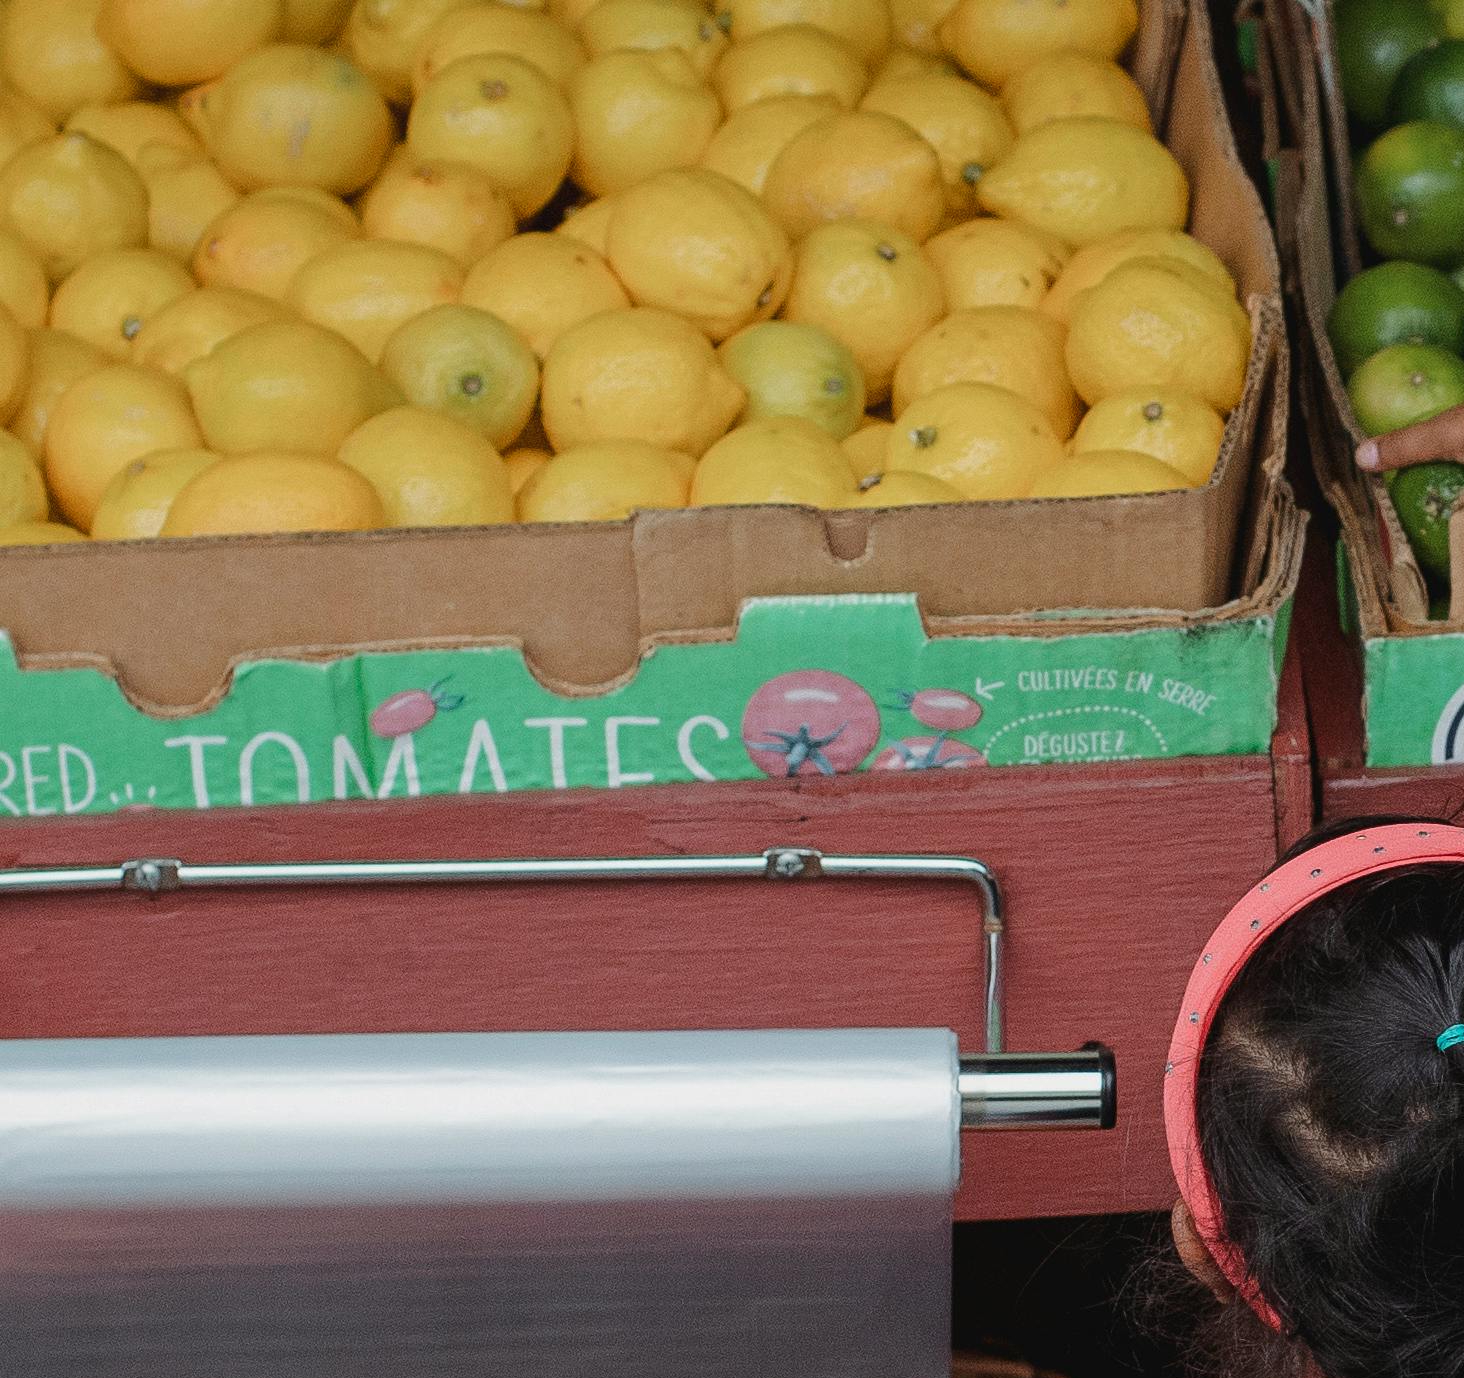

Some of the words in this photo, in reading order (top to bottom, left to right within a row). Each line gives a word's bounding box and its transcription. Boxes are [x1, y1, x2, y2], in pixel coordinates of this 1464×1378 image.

[1017, 665, 1118, 692] CULTIVÉES
[1124, 670, 1154, 695] EN
[1157, 678, 1217, 716] SERRE
